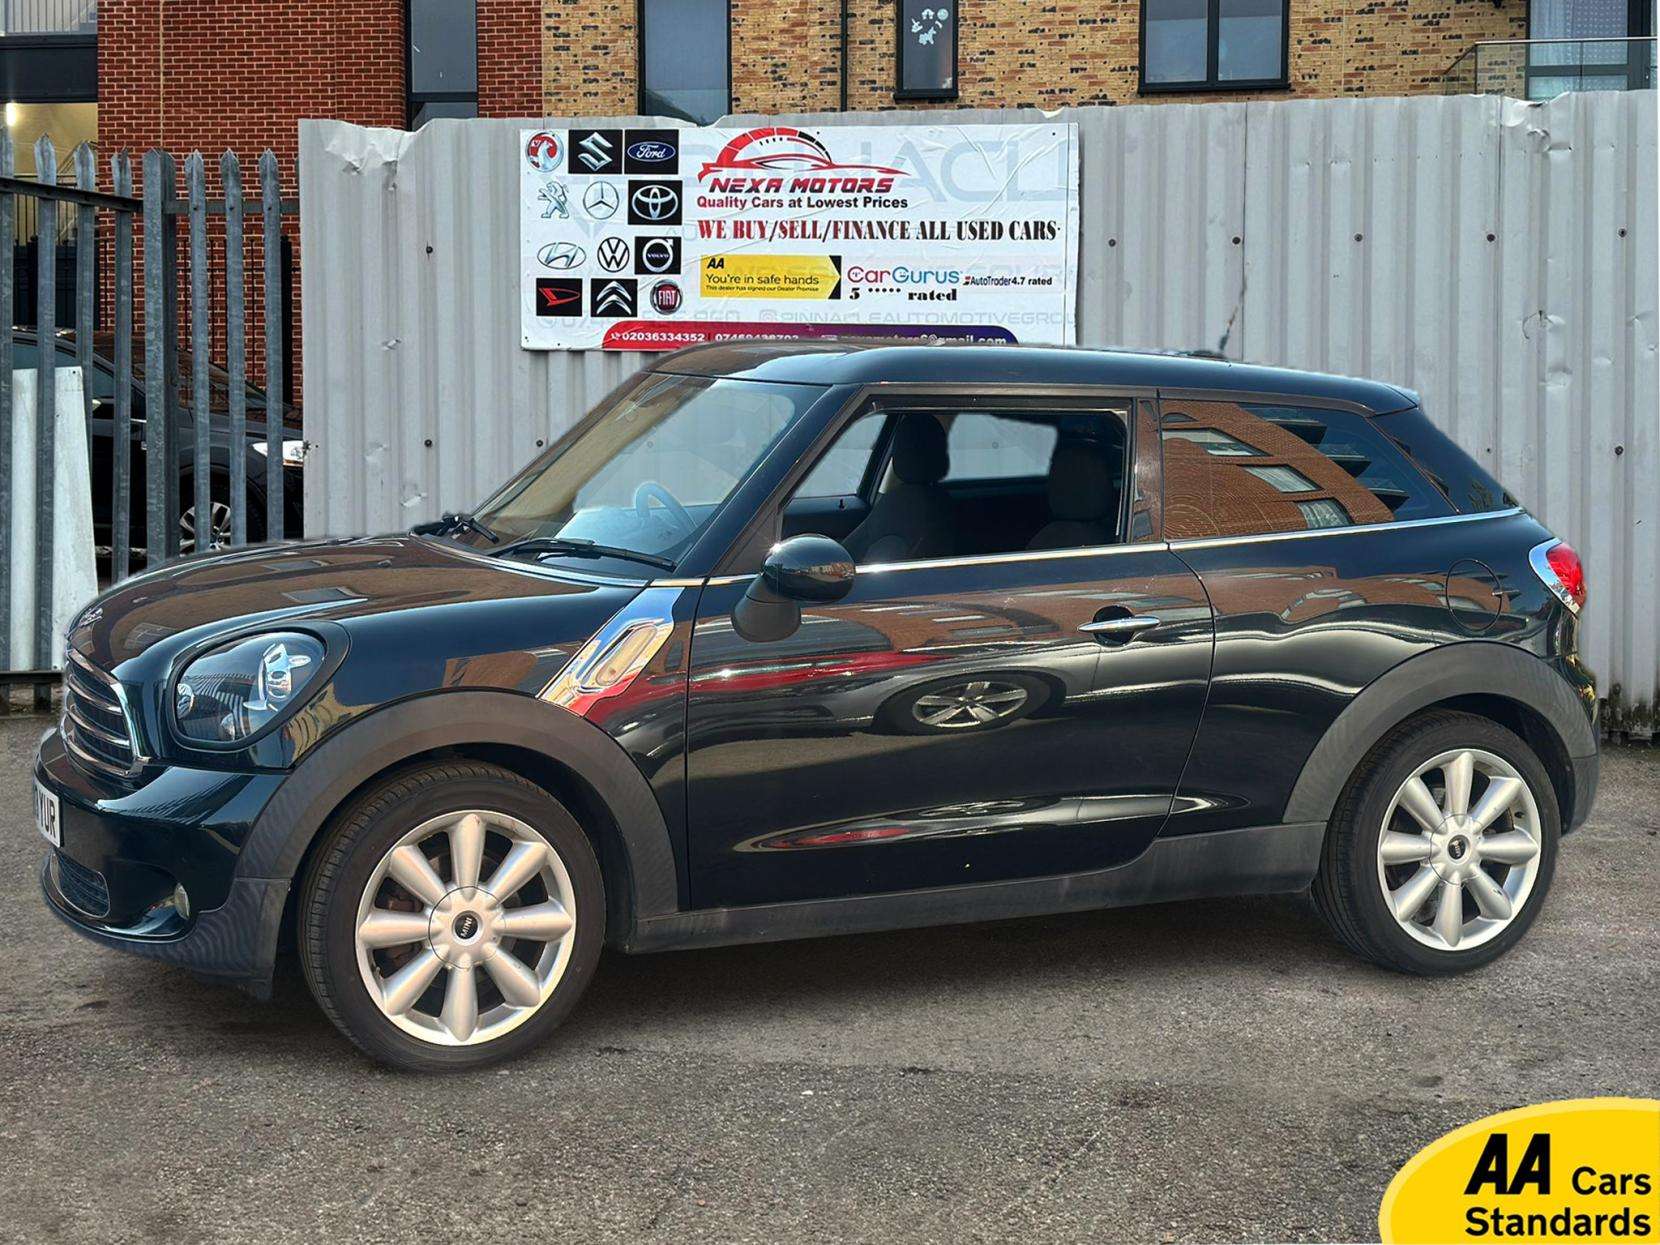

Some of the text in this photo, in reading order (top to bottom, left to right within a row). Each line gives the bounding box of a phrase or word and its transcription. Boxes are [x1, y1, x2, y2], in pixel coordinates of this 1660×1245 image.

[636, 144, 666, 159] Ford
[709, 178, 894, 194] NEXA MOTORS
[697, 196, 908, 210] Quality Cars at Lowest Prices
[697, 220, 727, 240] WE
[916, 220, 950, 241] ALL
[956, 220, 1004, 241] USED
[1008, 220, 1057, 241] CARS
[707, 257, 725, 269] AA
[705, 273, 820, 285] You're in safe hands
[847, 266, 960, 284] CarGurus
[1028, 277, 1053, 286] rated
[658, 290, 676, 306] FIAT
[849, 287, 957, 301] 5 rated
[621, 332, 705, 342] 02036334352
[460, 916, 473, 938] MINI
